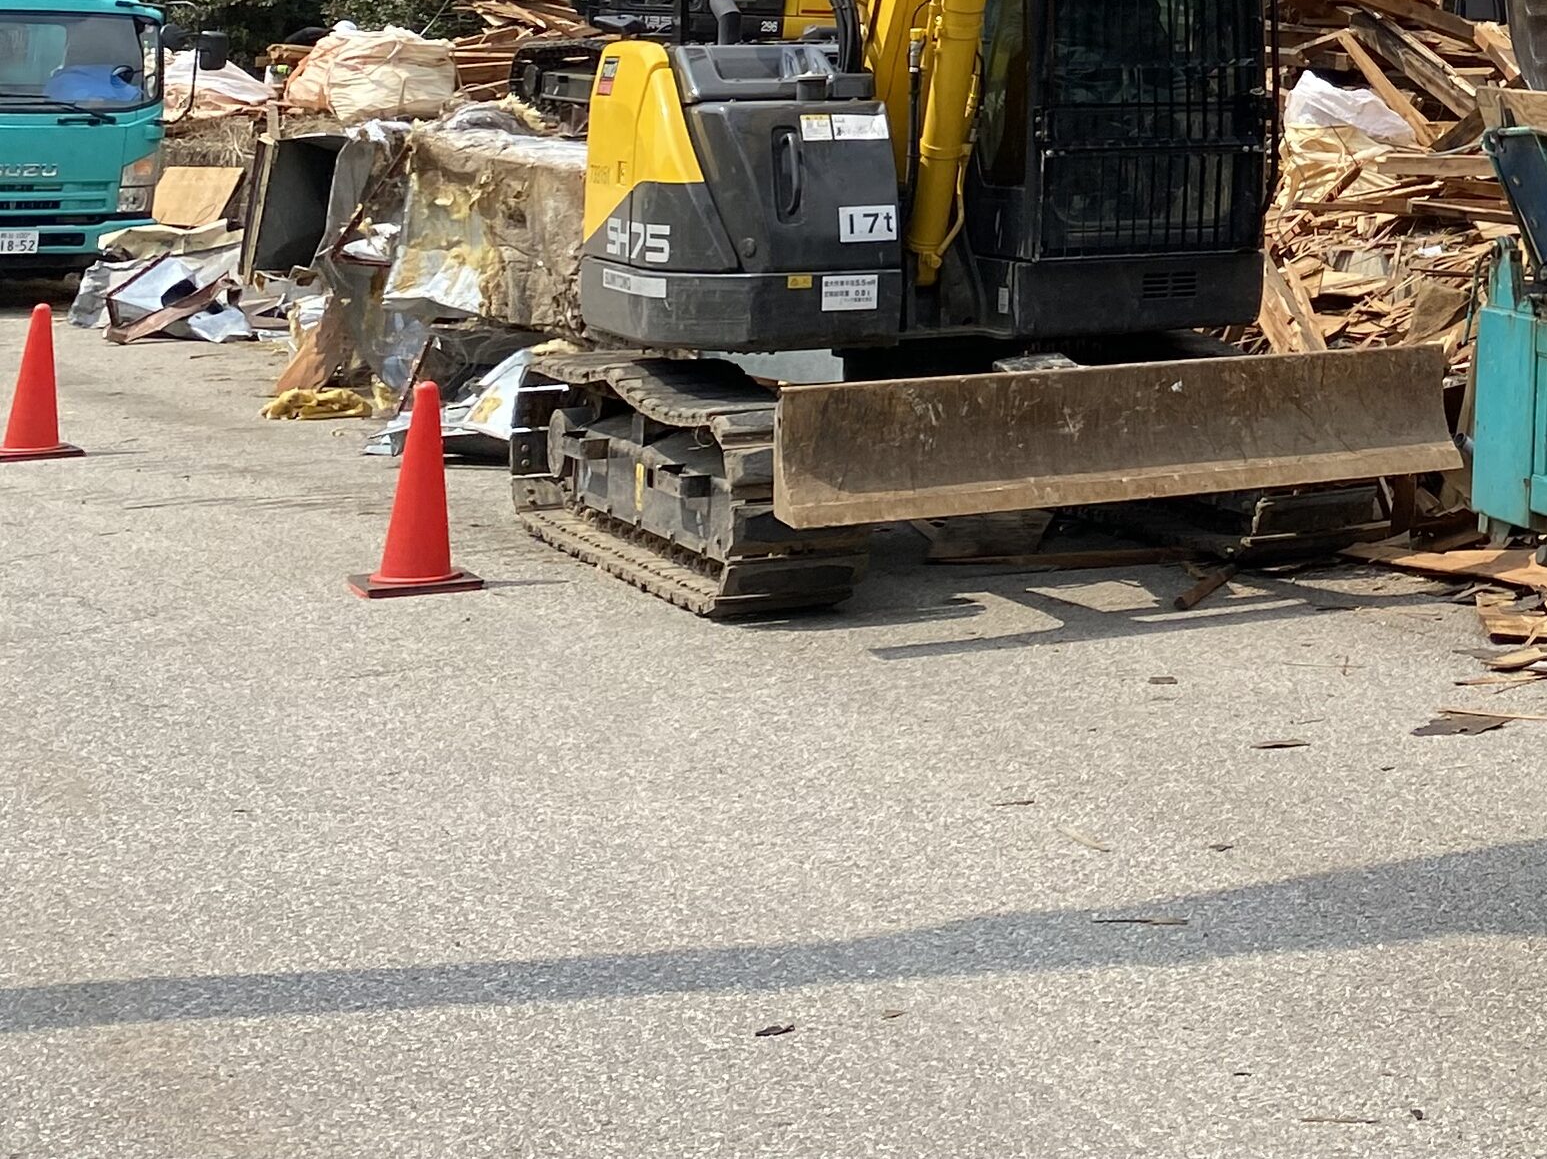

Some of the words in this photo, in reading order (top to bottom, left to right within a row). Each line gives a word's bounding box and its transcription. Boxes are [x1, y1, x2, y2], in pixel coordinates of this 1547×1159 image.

[760, 20, 777, 32] 296
[0, 163, 58, 177] UZU
[606, 217, 670, 263] SH75
